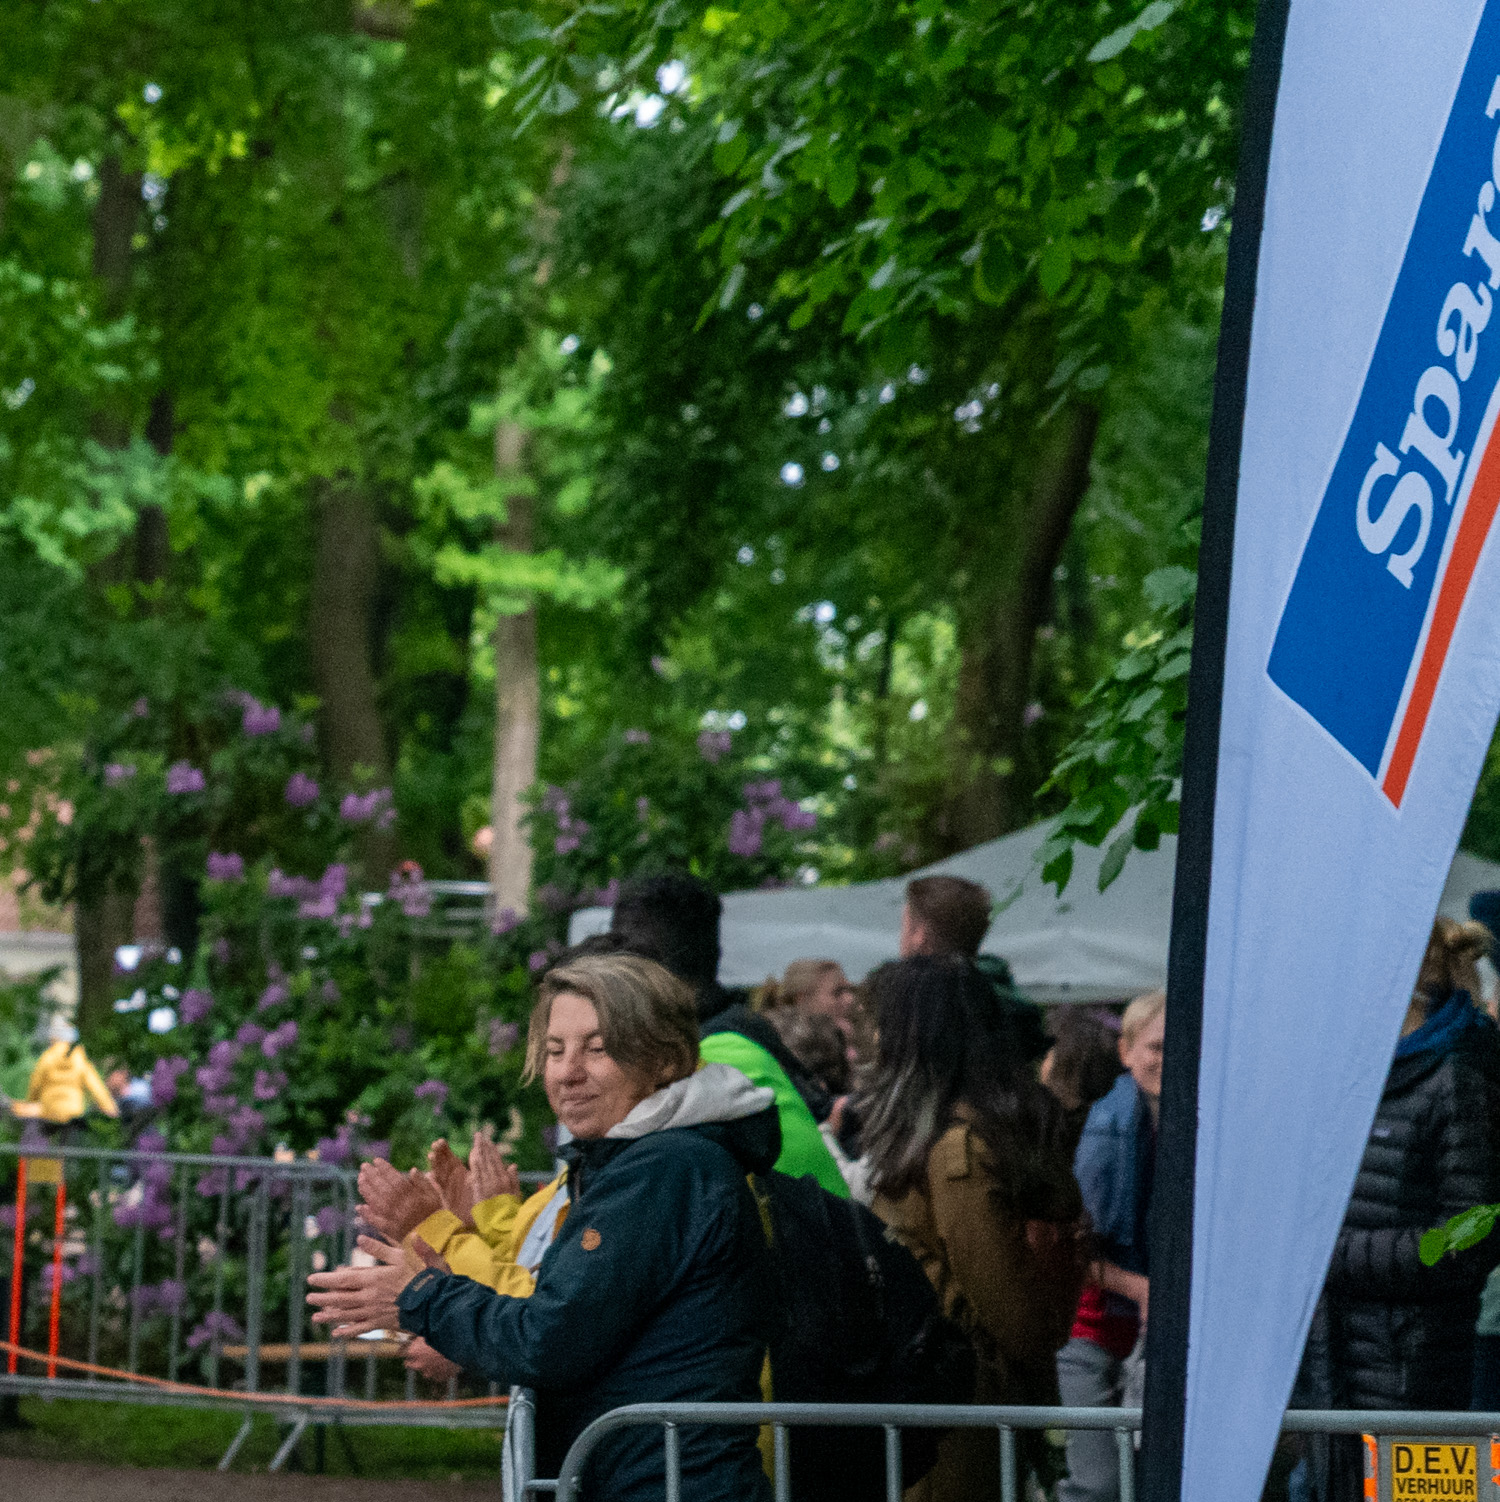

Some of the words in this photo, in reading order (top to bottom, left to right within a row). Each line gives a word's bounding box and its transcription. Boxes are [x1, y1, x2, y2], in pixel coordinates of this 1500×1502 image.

[1356, 75, 1500, 589] Spar
[1395, 1446, 1474, 1475] D.E.V.
[1395, 1478, 1474, 1495] VERHUUR
